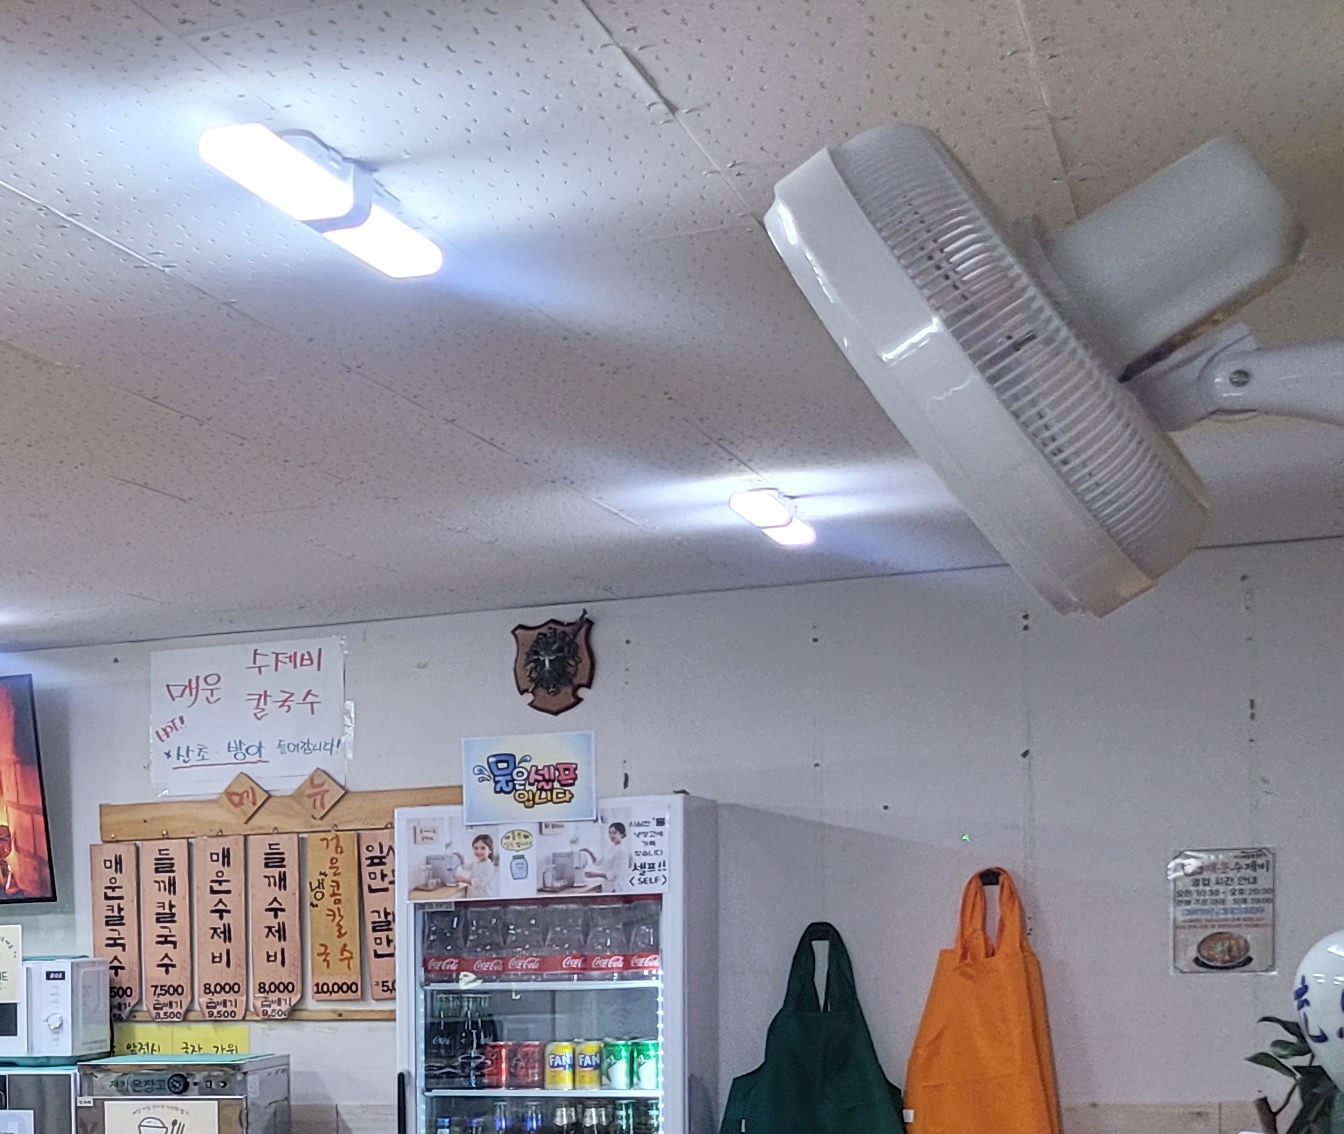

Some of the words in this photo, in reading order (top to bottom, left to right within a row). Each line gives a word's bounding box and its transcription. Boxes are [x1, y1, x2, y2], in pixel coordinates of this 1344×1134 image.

[246, 649, 322, 675] 수제비
[166, 673, 222, 707] 매운
[246, 689, 322, 720] 칼국수
[226, 742, 265, 760] 방아
[277, 739, 342, 755] 들어갑니다!
[487, 753, 528, 794] 물은
[528, 763, 578, 789] 셀프
[514, 788, 574, 809] 입니다
[103, 853, 126, 978] 매운칼국수
[153, 848, 177, 976] 들깨칼국수
[209, 847, 232, 969] 매운수제비
[263, 842, 287, 968] 들깨수제비
[370, 907, 395, 933] 갈
[374, 935, 395, 959] 만
[151, 984, 185, 998] 7,500
[203, 982, 241, 995] 8,000
[258, 981, 295, 994] 8,000
[314, 982, 359, 995] 10,000
